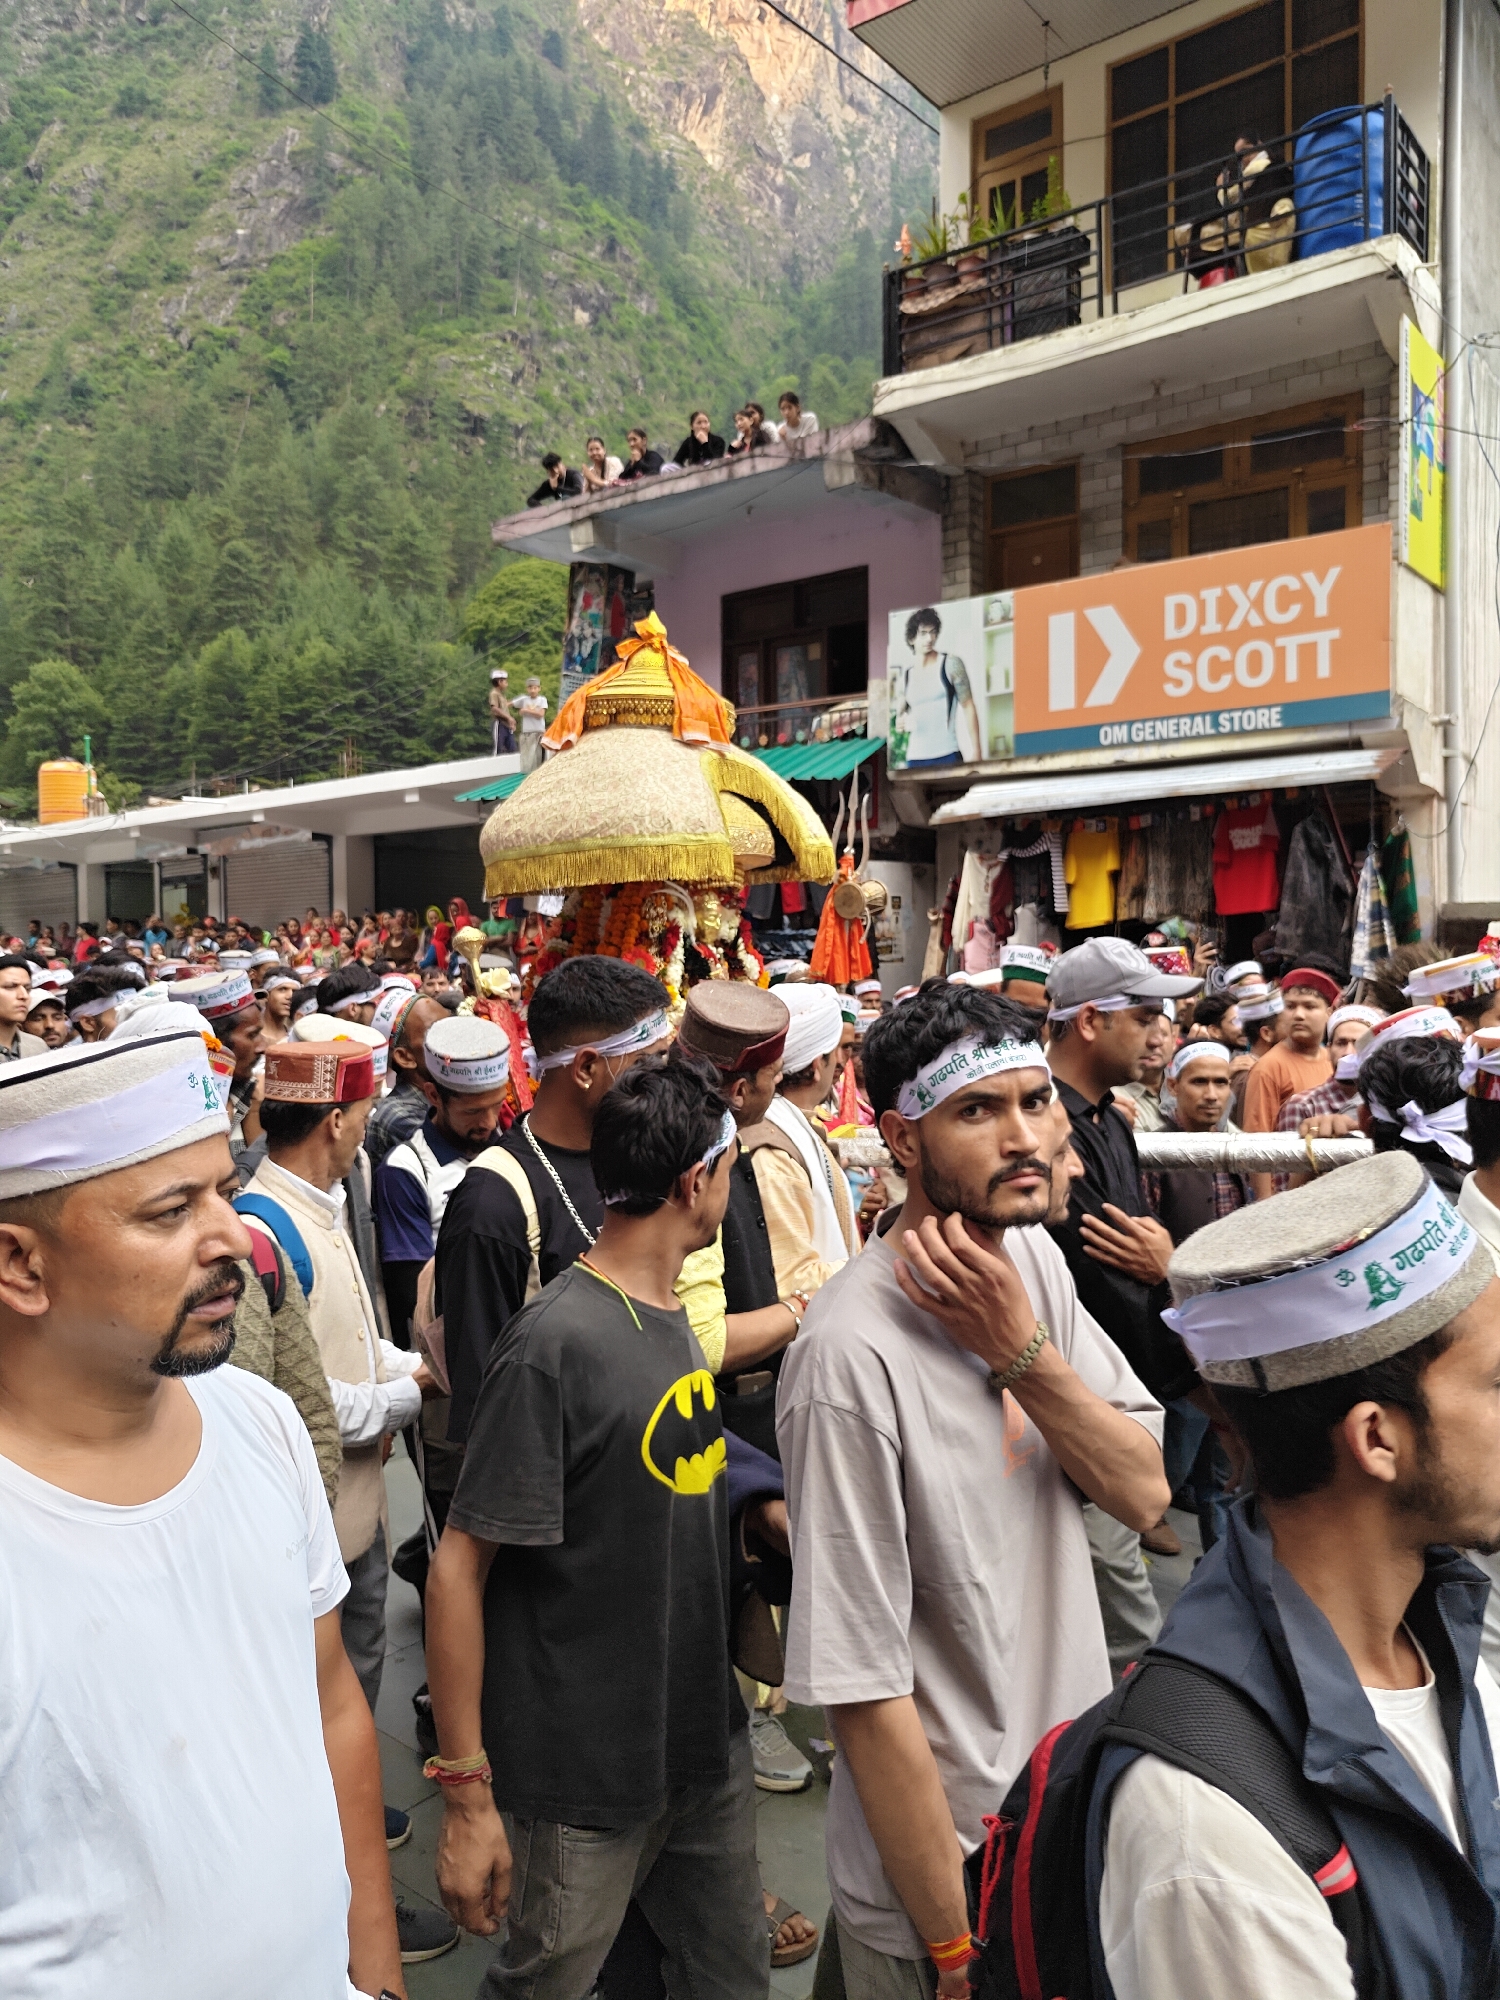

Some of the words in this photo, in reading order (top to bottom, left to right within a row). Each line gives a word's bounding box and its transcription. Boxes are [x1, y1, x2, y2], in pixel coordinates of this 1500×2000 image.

[1164, 565, 1342, 641] DIXCY
[1163, 628, 1341, 698] SCOTT
[1099, 724, 1129, 746] OM
[1130, 713, 1216, 743] GENERAL
[1217, 706, 1282, 733] STORE
